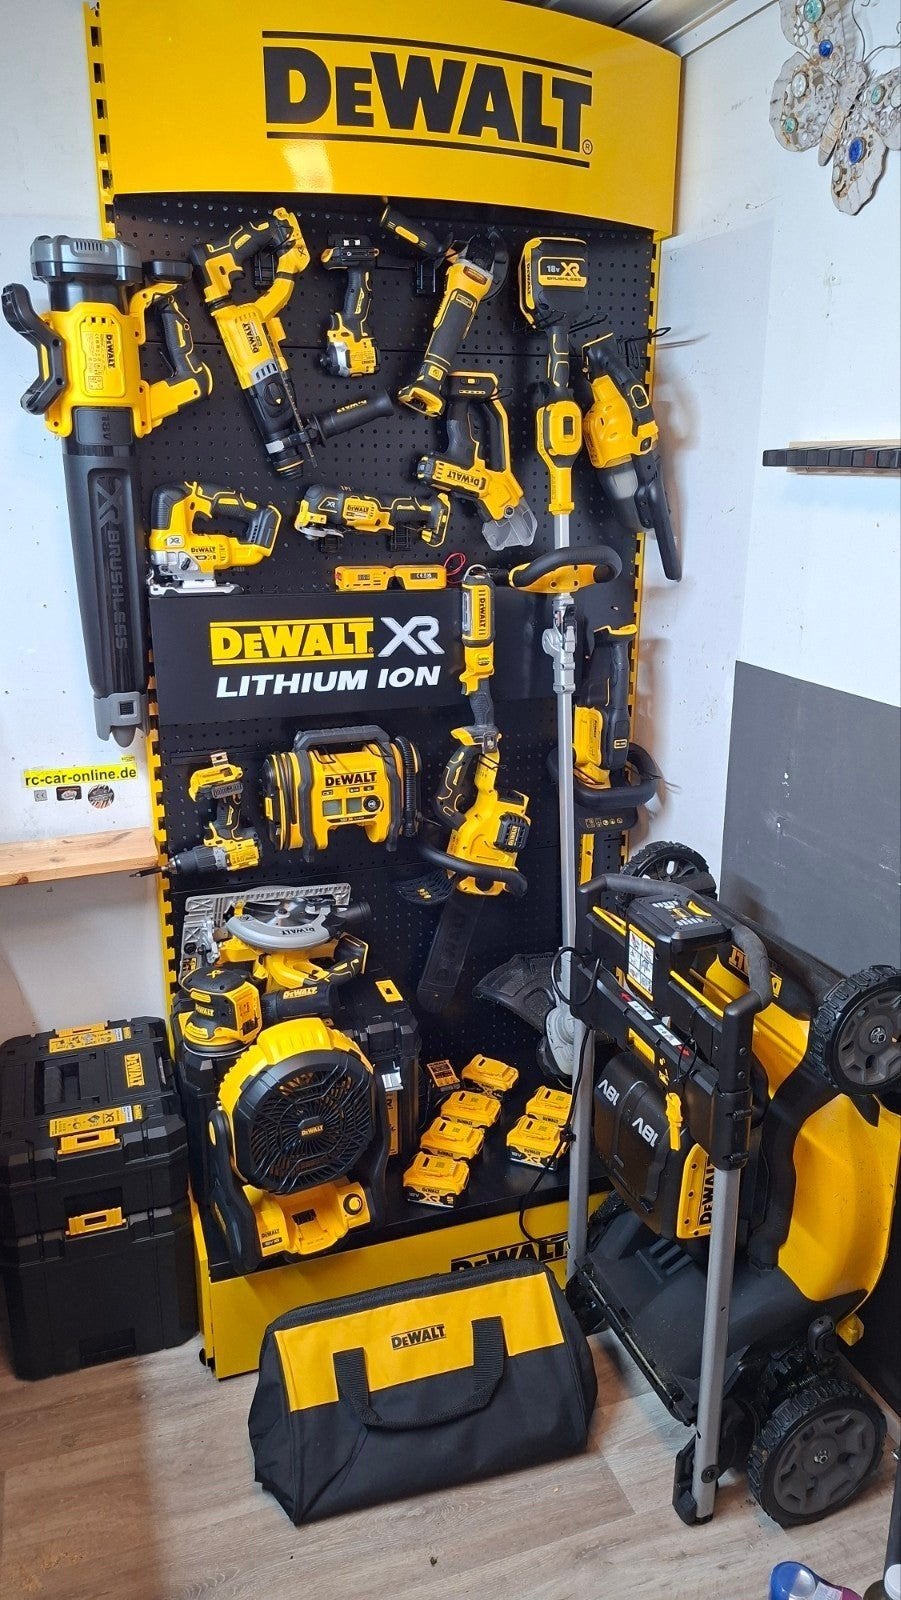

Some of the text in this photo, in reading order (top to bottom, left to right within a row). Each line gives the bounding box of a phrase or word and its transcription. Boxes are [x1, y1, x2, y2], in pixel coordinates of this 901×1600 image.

[263, 46, 592, 152] DEWALT
[242, 322, 259, 354] DEWALT
[106, 334, 116, 369] DEWALT
[446, 470, 480, 486] DEWALT
[346, 505, 369, 513] DEWALT
[107, 529, 129, 651] BRUSHLESS
[478, 597, 486, 628] DEWALT
[210, 615, 445, 660] DEWALT XR
[216, 665, 441, 698] LITHIUM ION
[25, 766, 137, 786] rc-car-online.de
[325, 771, 377, 787] DEWALT
[281, 927, 316, 935] DEWALT
[282, 986, 318, 1000] DEWALT
[195, 1003, 215, 1017] DEWALT
[125, 1054, 144, 1088] DEWALT
[598, 1079, 620, 1107] 18V
[301, 1124, 324, 1136] DEWALT
[632, 1117, 659, 1148] 18V
[261, 1228, 280, 1239] DEWALT
[390, 1325, 445, 1349] DEWALT
